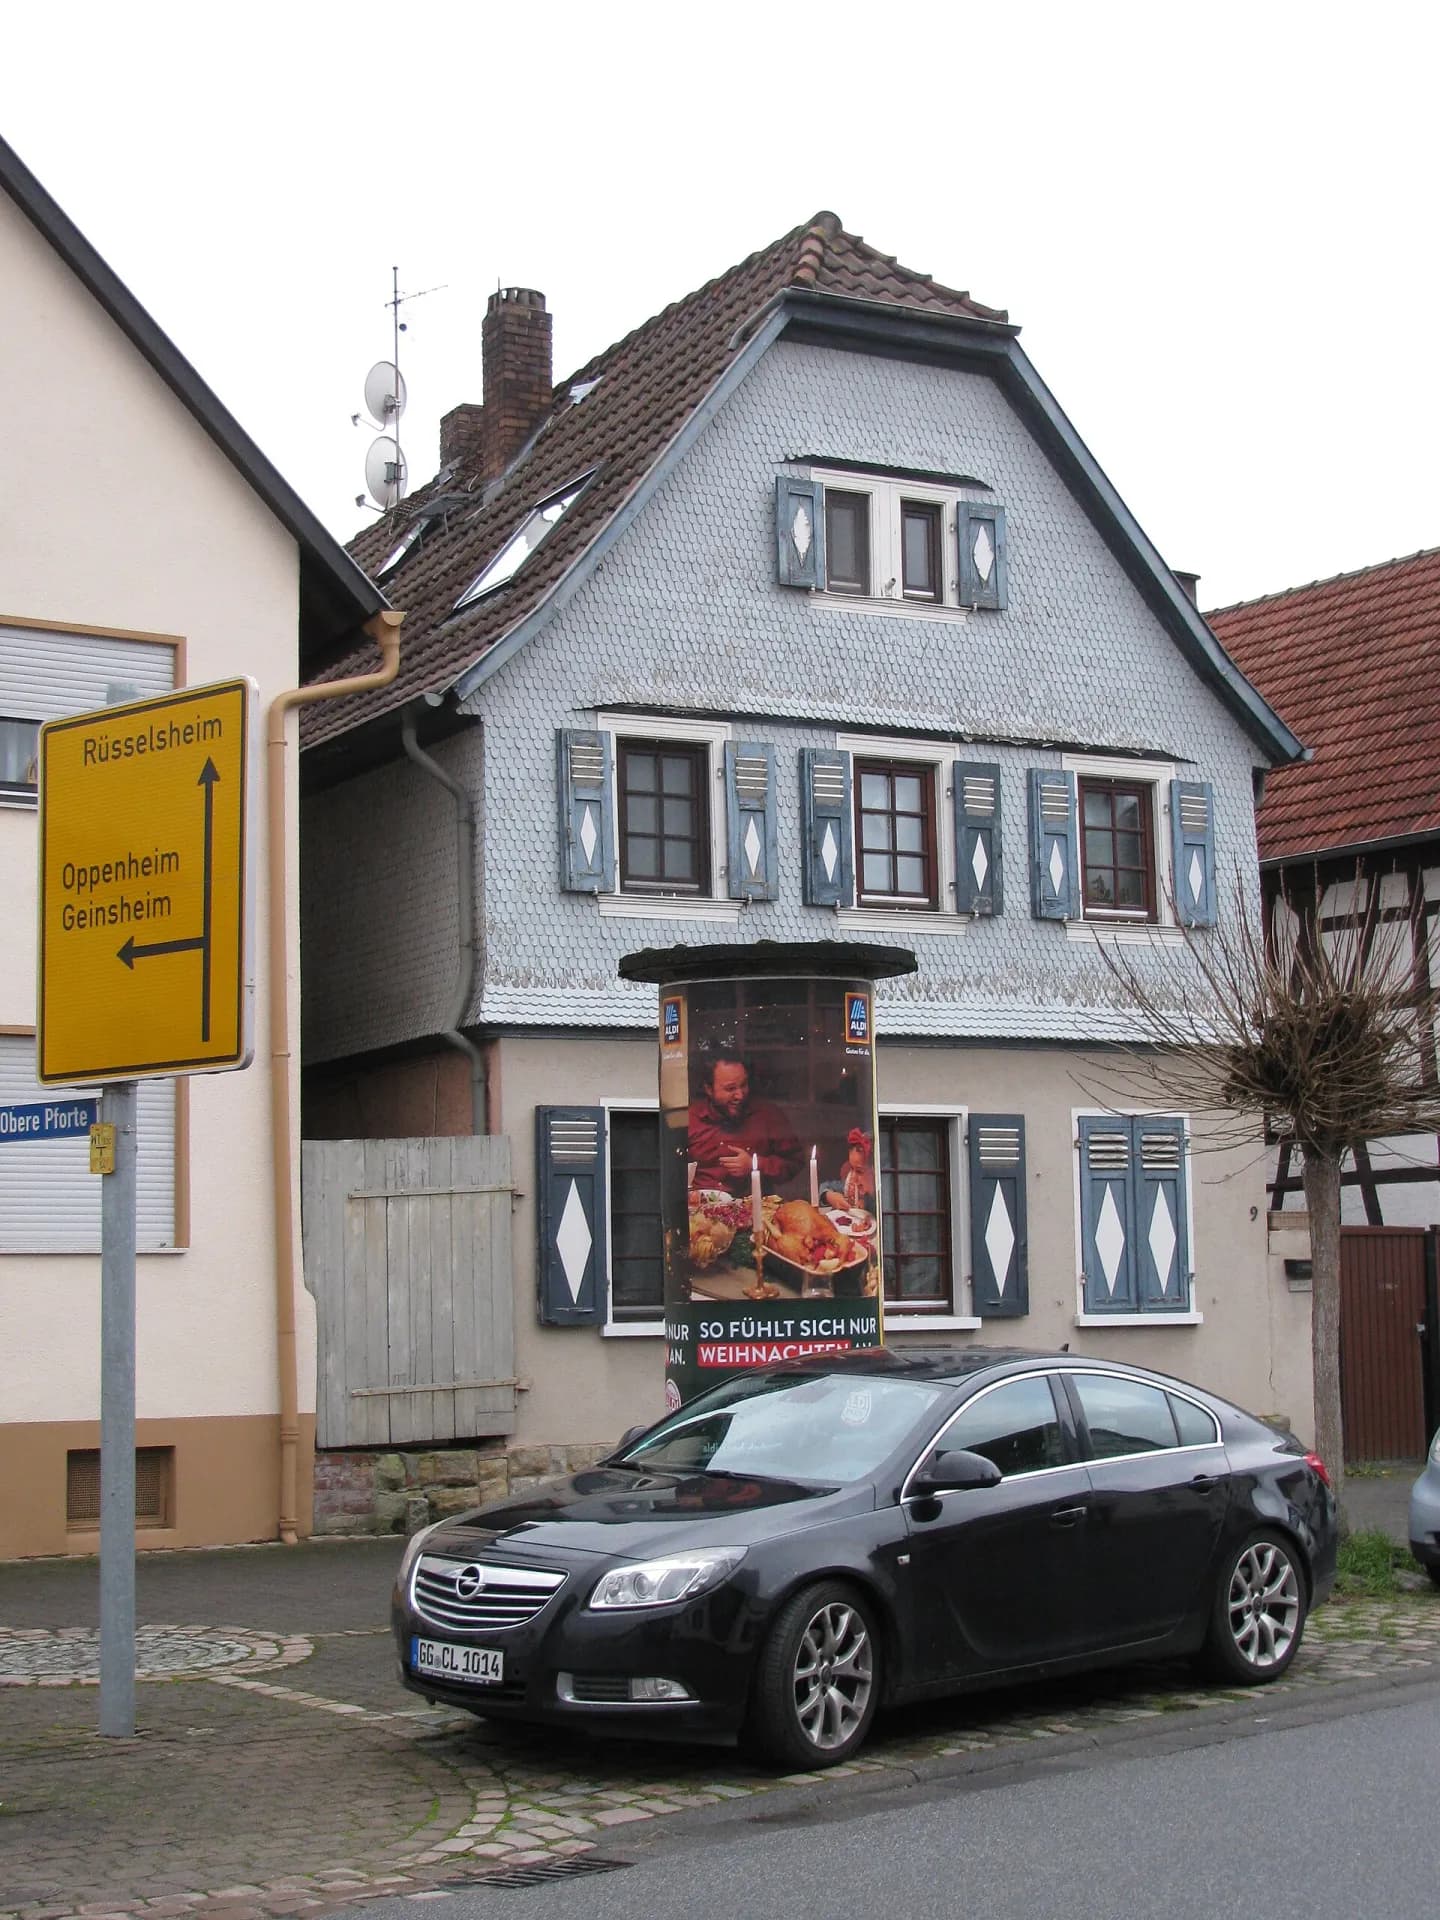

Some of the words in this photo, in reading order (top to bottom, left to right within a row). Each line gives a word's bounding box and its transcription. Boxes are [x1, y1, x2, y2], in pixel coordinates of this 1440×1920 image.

[84, 715, 222, 766] Rüsselsheim
[62, 848, 180, 895] Oppenheim
[62, 892, 171, 931] Geinsheim
[850, 1021, 867, 1031] ALDI
[0, 1111, 40, 1133] Obere
[44, 1107, 88, 1130] Pforte
[1250, 1206, 1258, 1221] 9
[668, 1324, 689, 1340] NUR
[700, 1321, 724, 1339] SO
[729, 1317, 795, 1338] FÜHLT
[800, 1319, 845, 1337] SICH
[850, 1317, 877, 1335] NUR
[419, 1642, 434, 1665] GG
[442, 1647, 458, 1670] CL
[462, 1650, 500, 1677] 1014
